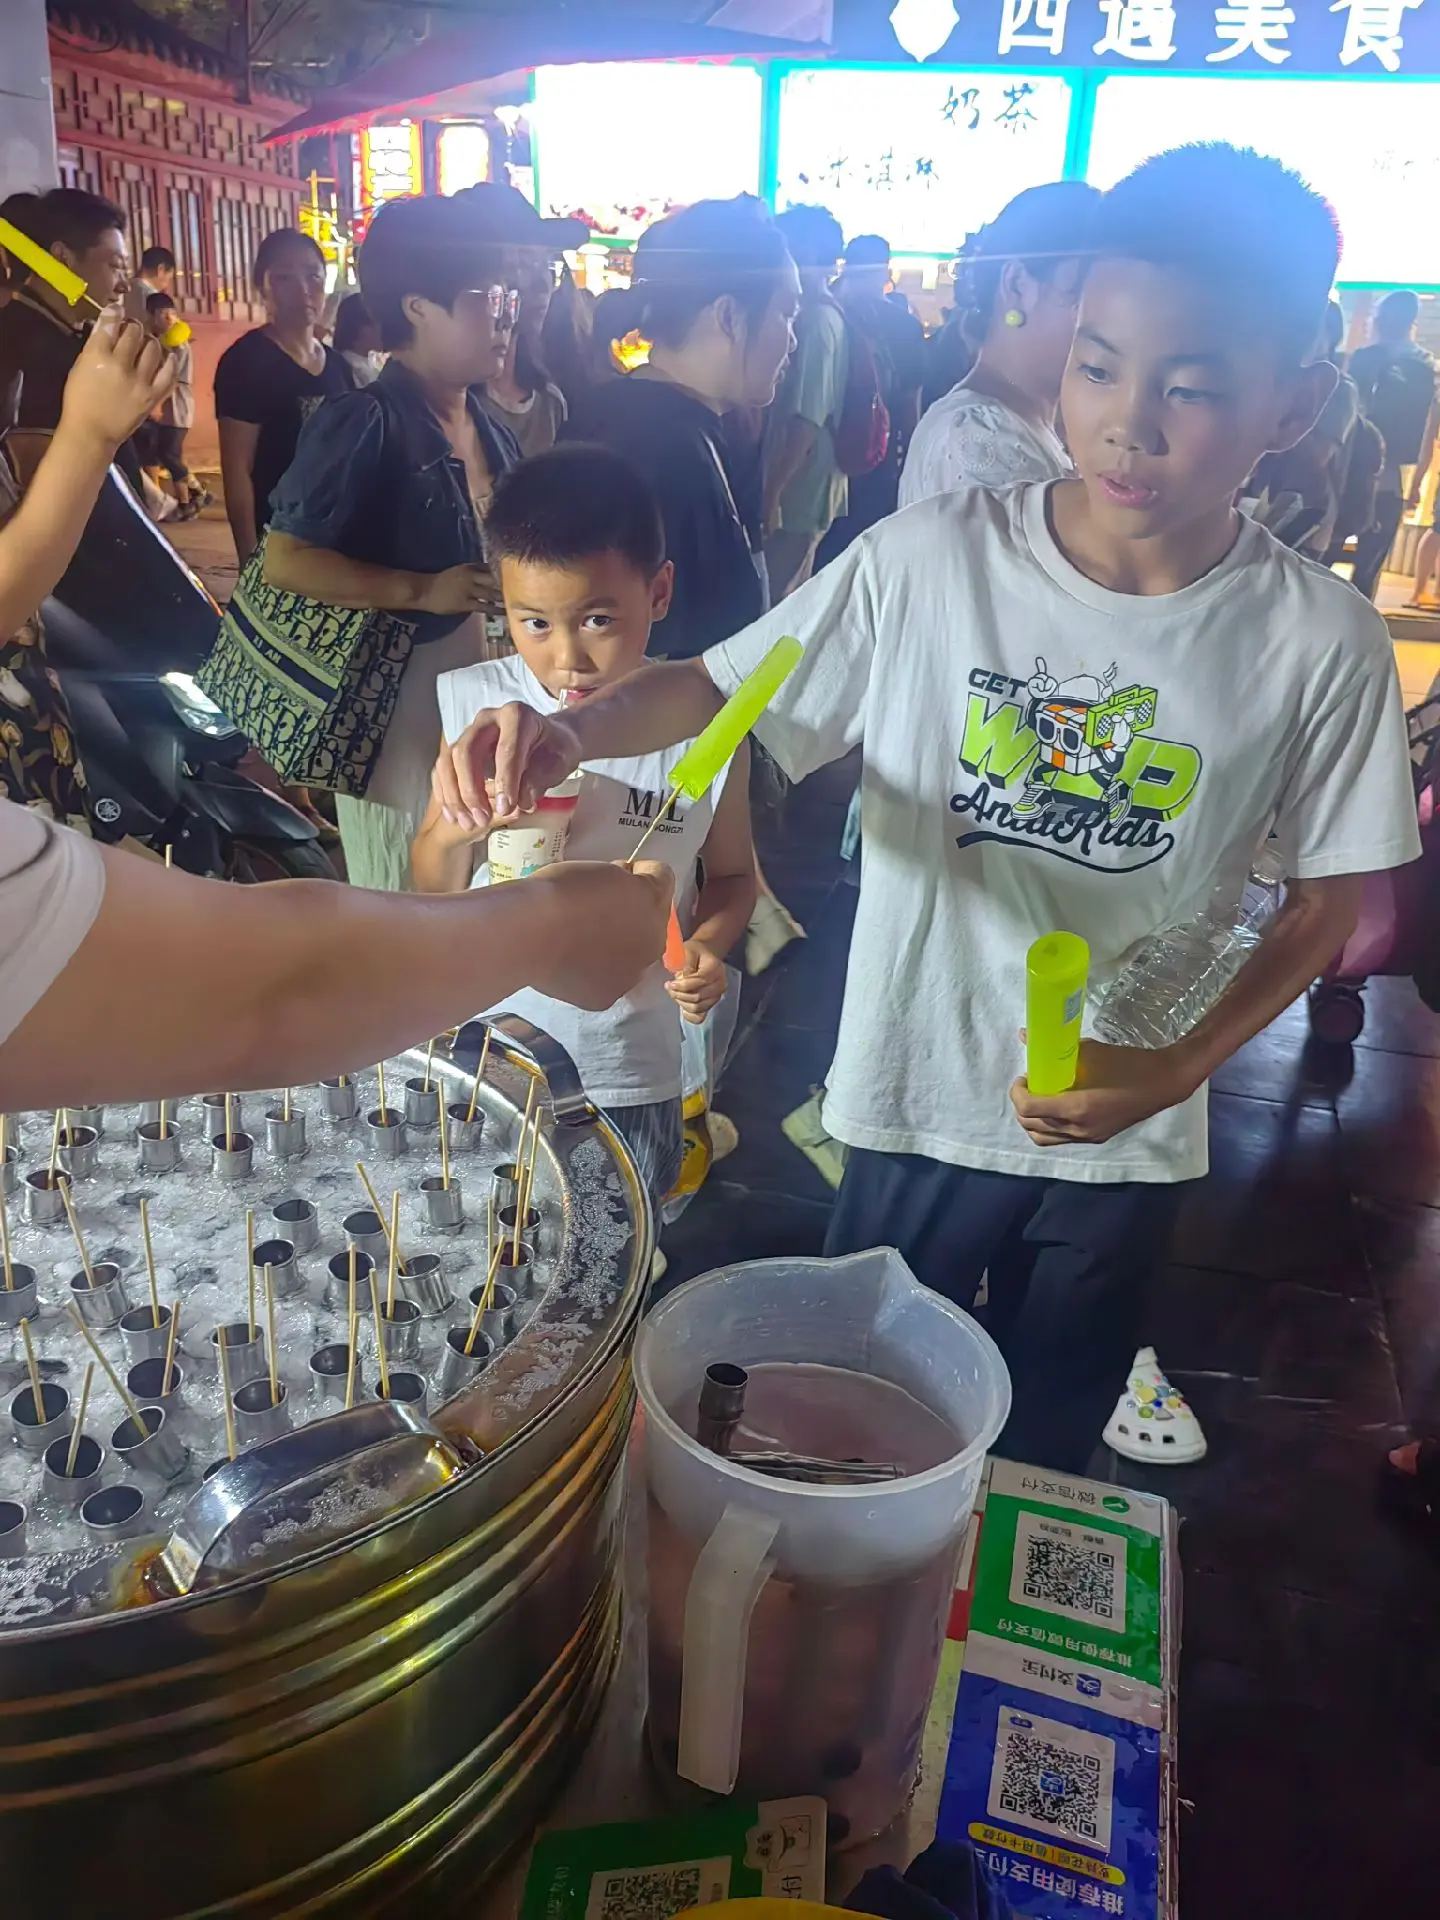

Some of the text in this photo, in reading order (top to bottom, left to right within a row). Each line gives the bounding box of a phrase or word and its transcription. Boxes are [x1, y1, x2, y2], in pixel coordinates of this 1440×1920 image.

[938, 82, 1038, 134] 奶茶
[968, 667, 1028, 698] GET
[618, 817, 684, 834] MULANONGZI
[1020, 1476, 1097, 1506] 微信支付
[997, 1617, 1133, 1668] 推荐使用微信支付
[1022, 1658, 1075, 1686] 支付宝
